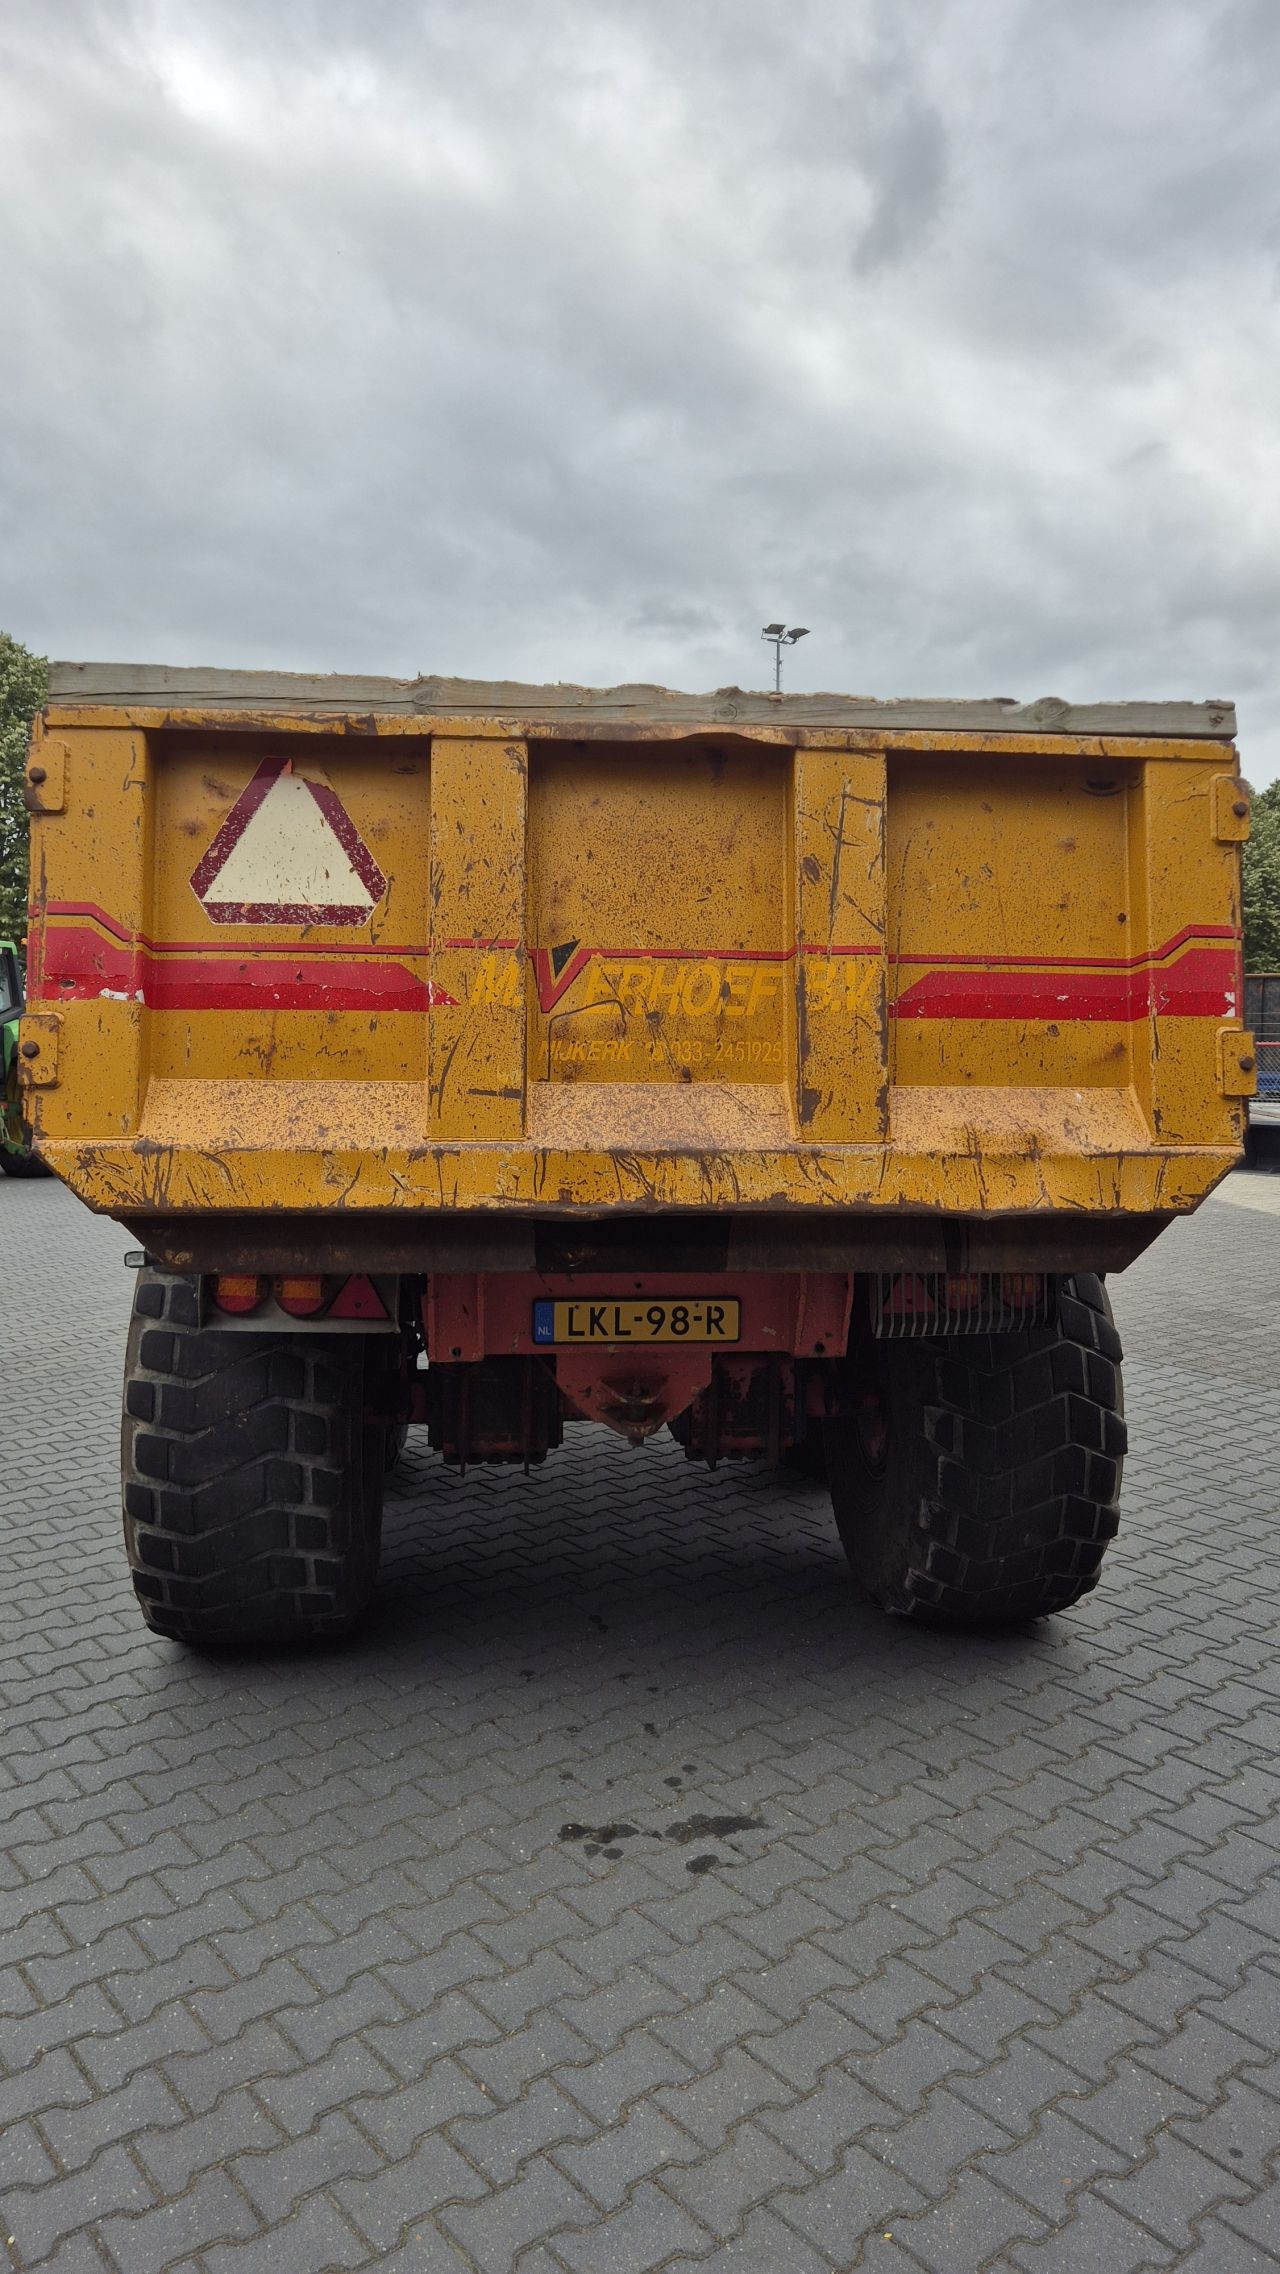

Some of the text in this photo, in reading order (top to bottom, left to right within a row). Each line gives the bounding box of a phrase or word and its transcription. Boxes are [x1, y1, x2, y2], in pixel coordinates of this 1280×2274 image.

[538, 1040, 634, 1061] NIJKERK
[537, 1305, 726, 1337] NL LKL-98-R
